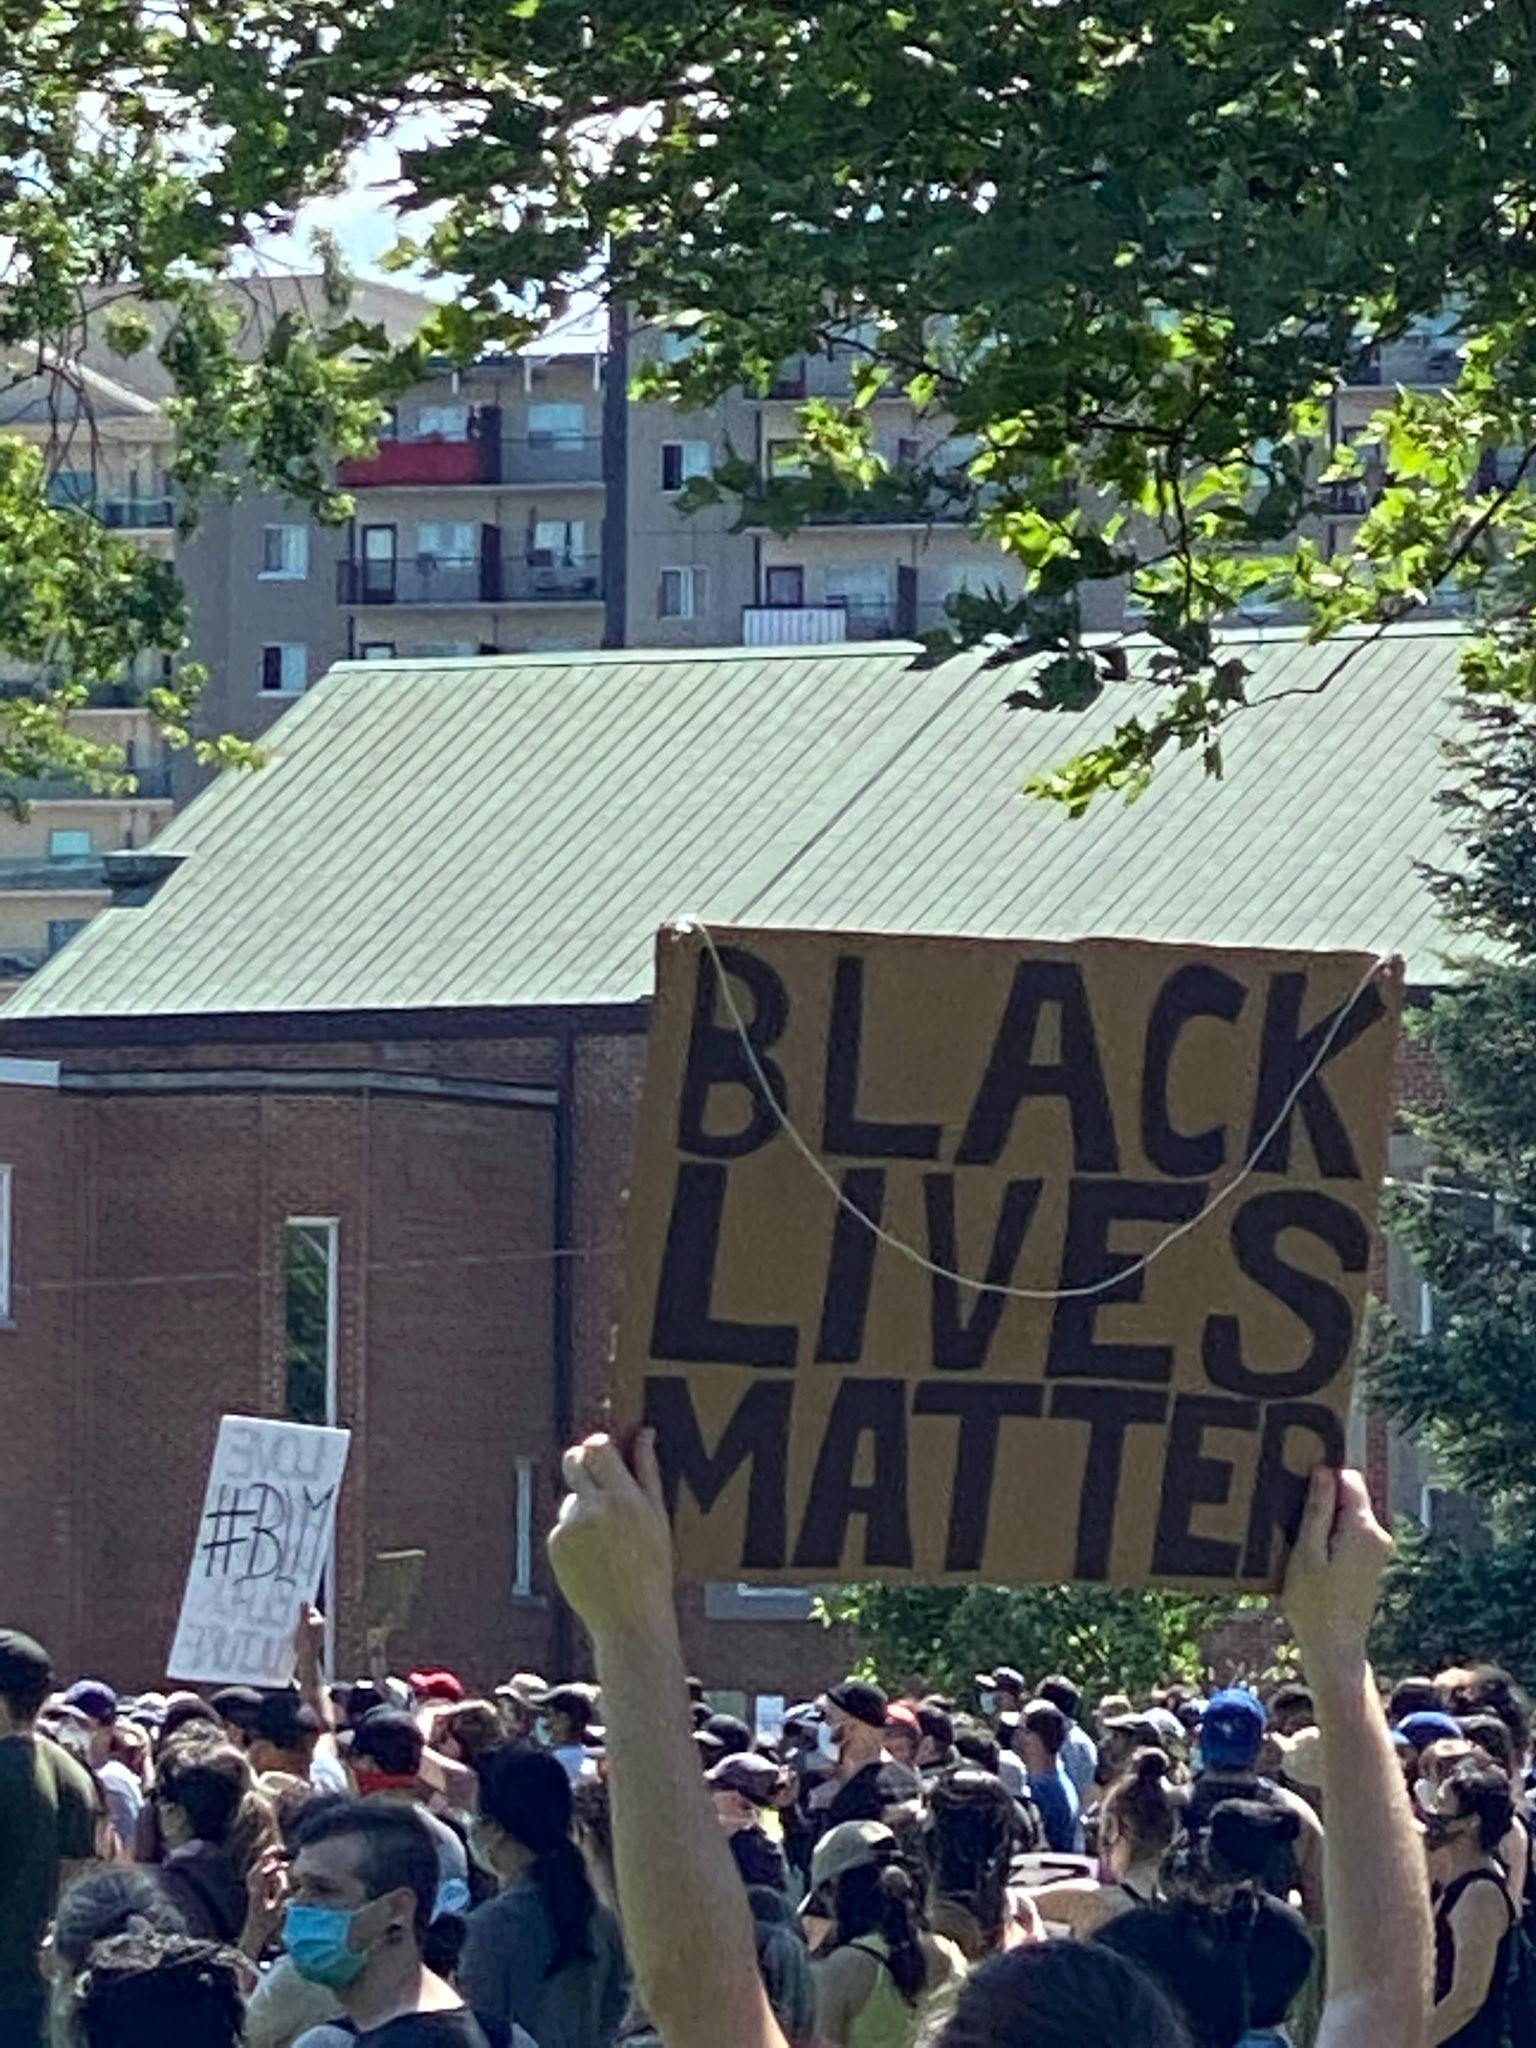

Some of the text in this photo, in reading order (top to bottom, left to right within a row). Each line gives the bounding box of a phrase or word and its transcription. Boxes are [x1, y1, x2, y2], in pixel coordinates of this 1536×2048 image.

[675, 945, 1388, 1181] BLACK
[649, 1161, 1371, 1398] LIVES
[643, 1375, 1346, 1581] MATTER
